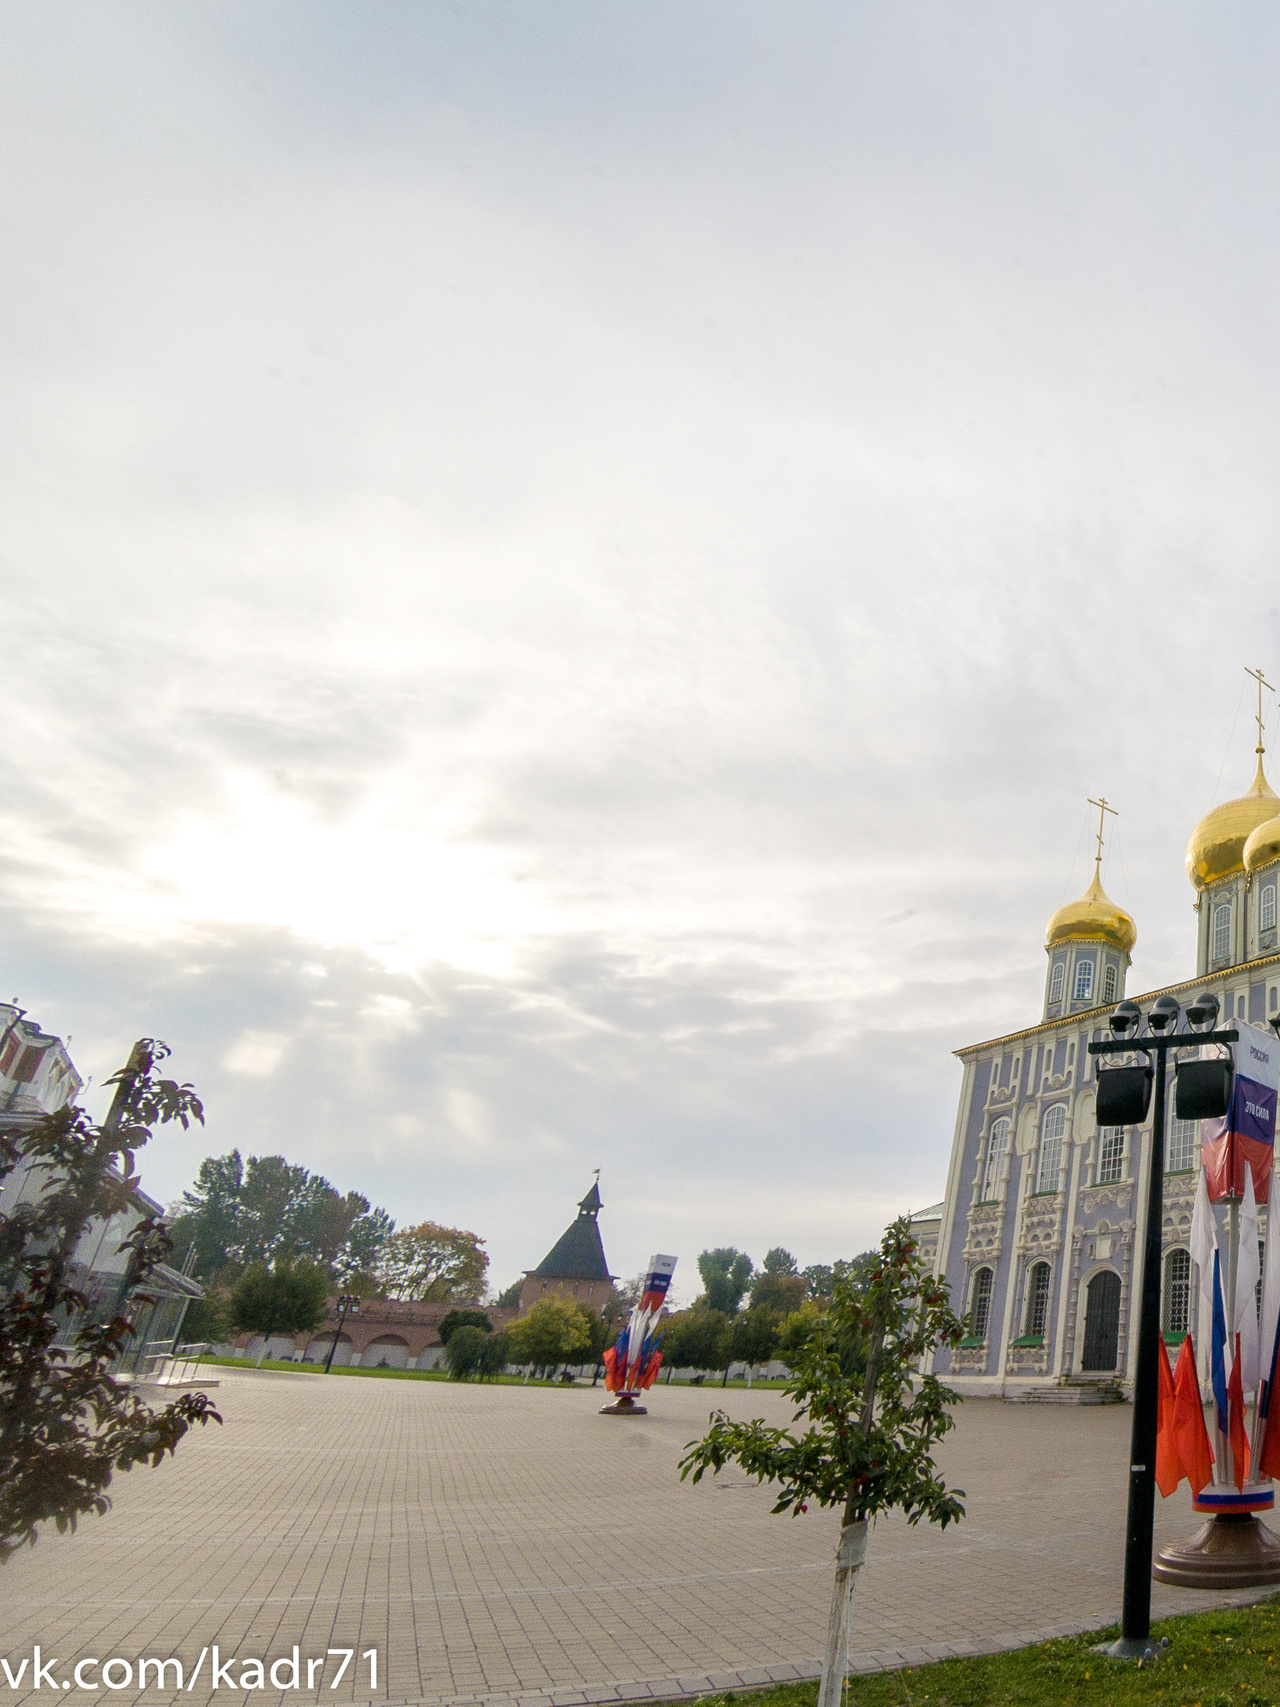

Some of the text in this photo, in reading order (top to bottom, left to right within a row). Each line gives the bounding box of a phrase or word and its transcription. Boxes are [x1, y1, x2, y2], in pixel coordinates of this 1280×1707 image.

[1250, 1046, 1269, 1064] РОССИЯ
[1245, 1101, 1269, 1121] ЭТО СИЛА
